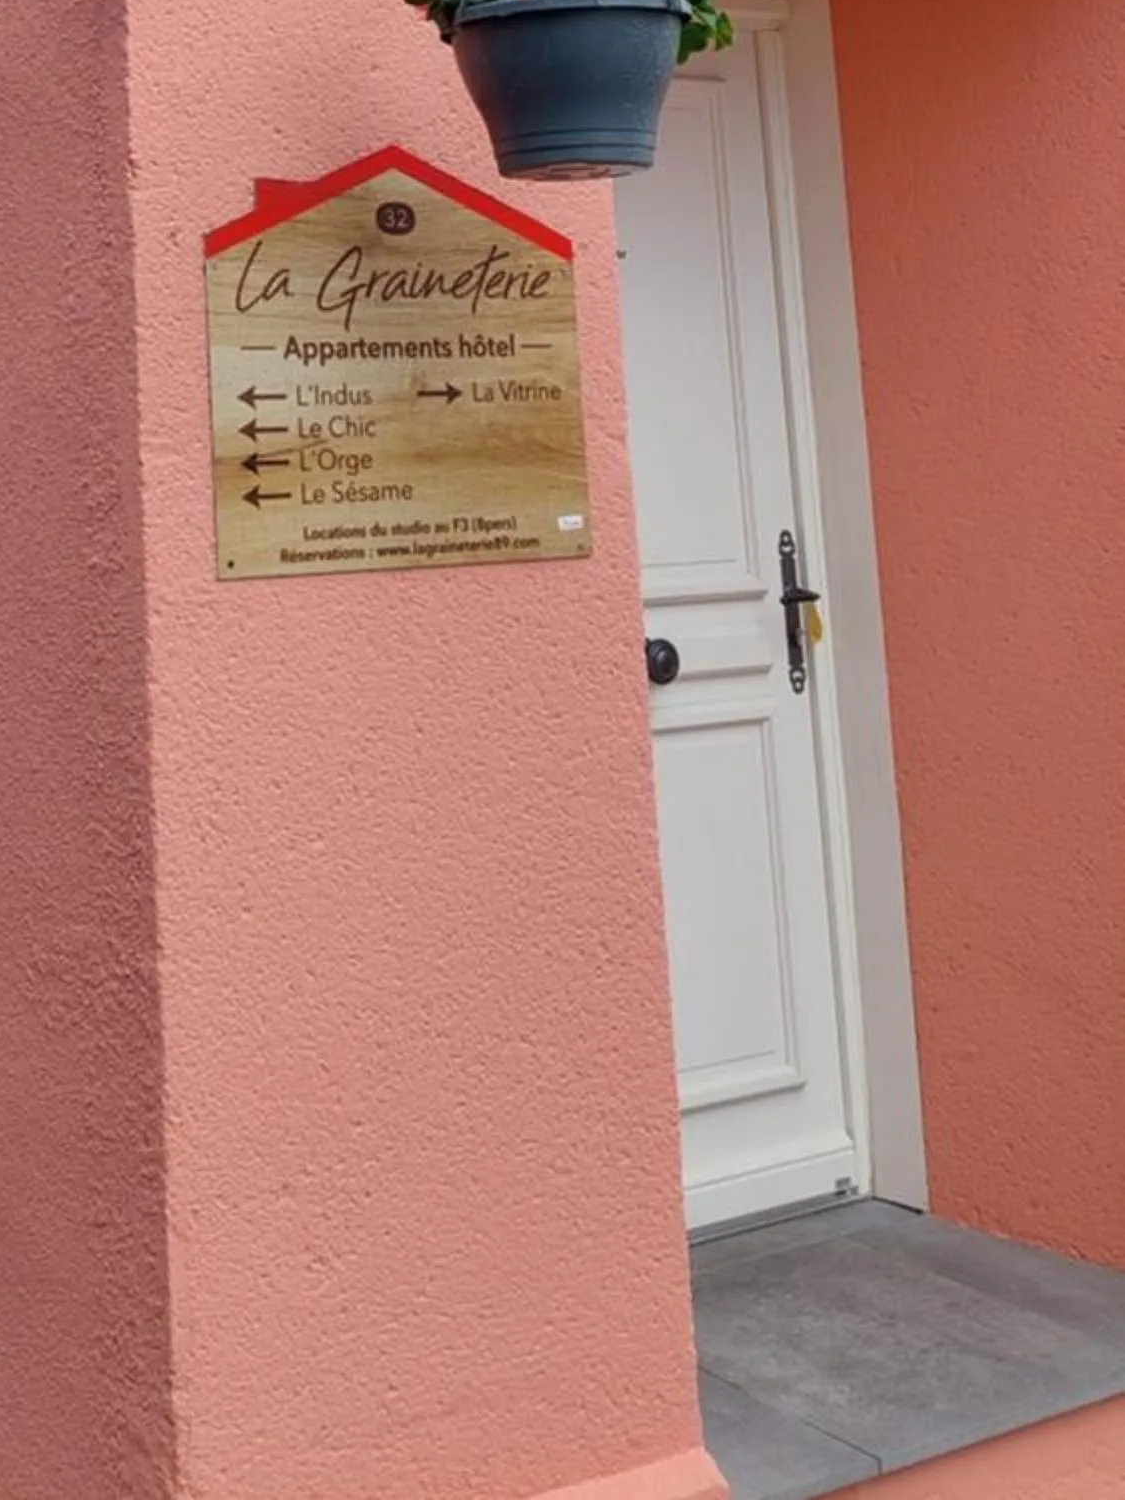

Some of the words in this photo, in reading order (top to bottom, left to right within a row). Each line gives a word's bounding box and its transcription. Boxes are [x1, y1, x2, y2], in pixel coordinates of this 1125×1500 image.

[383, 208, 410, 229] 32
[235, 239, 296, 314] La
[317, 243, 552, 333] Graineterie
[283, 334, 453, 367] Appartements
[458, 332, 515, 358] hôtel
[296, 381, 374, 406] L'Indus
[472, 381, 495, 403] La
[498, 378, 563, 402] Vitrine
[298, 417, 323, 439] Le
[328, 414, 378, 438] Chic
[299, 448, 374, 477] L'Orge
[301, 482, 325, 505] Le
[331, 479, 414, 504] Sésame
[302, 524, 367, 542] Locations
[370, 521, 388, 537] du
[391, 520, 431, 536] studio
[452, 515, 469, 532] F3
[280, 546, 366, 563] Réservations
